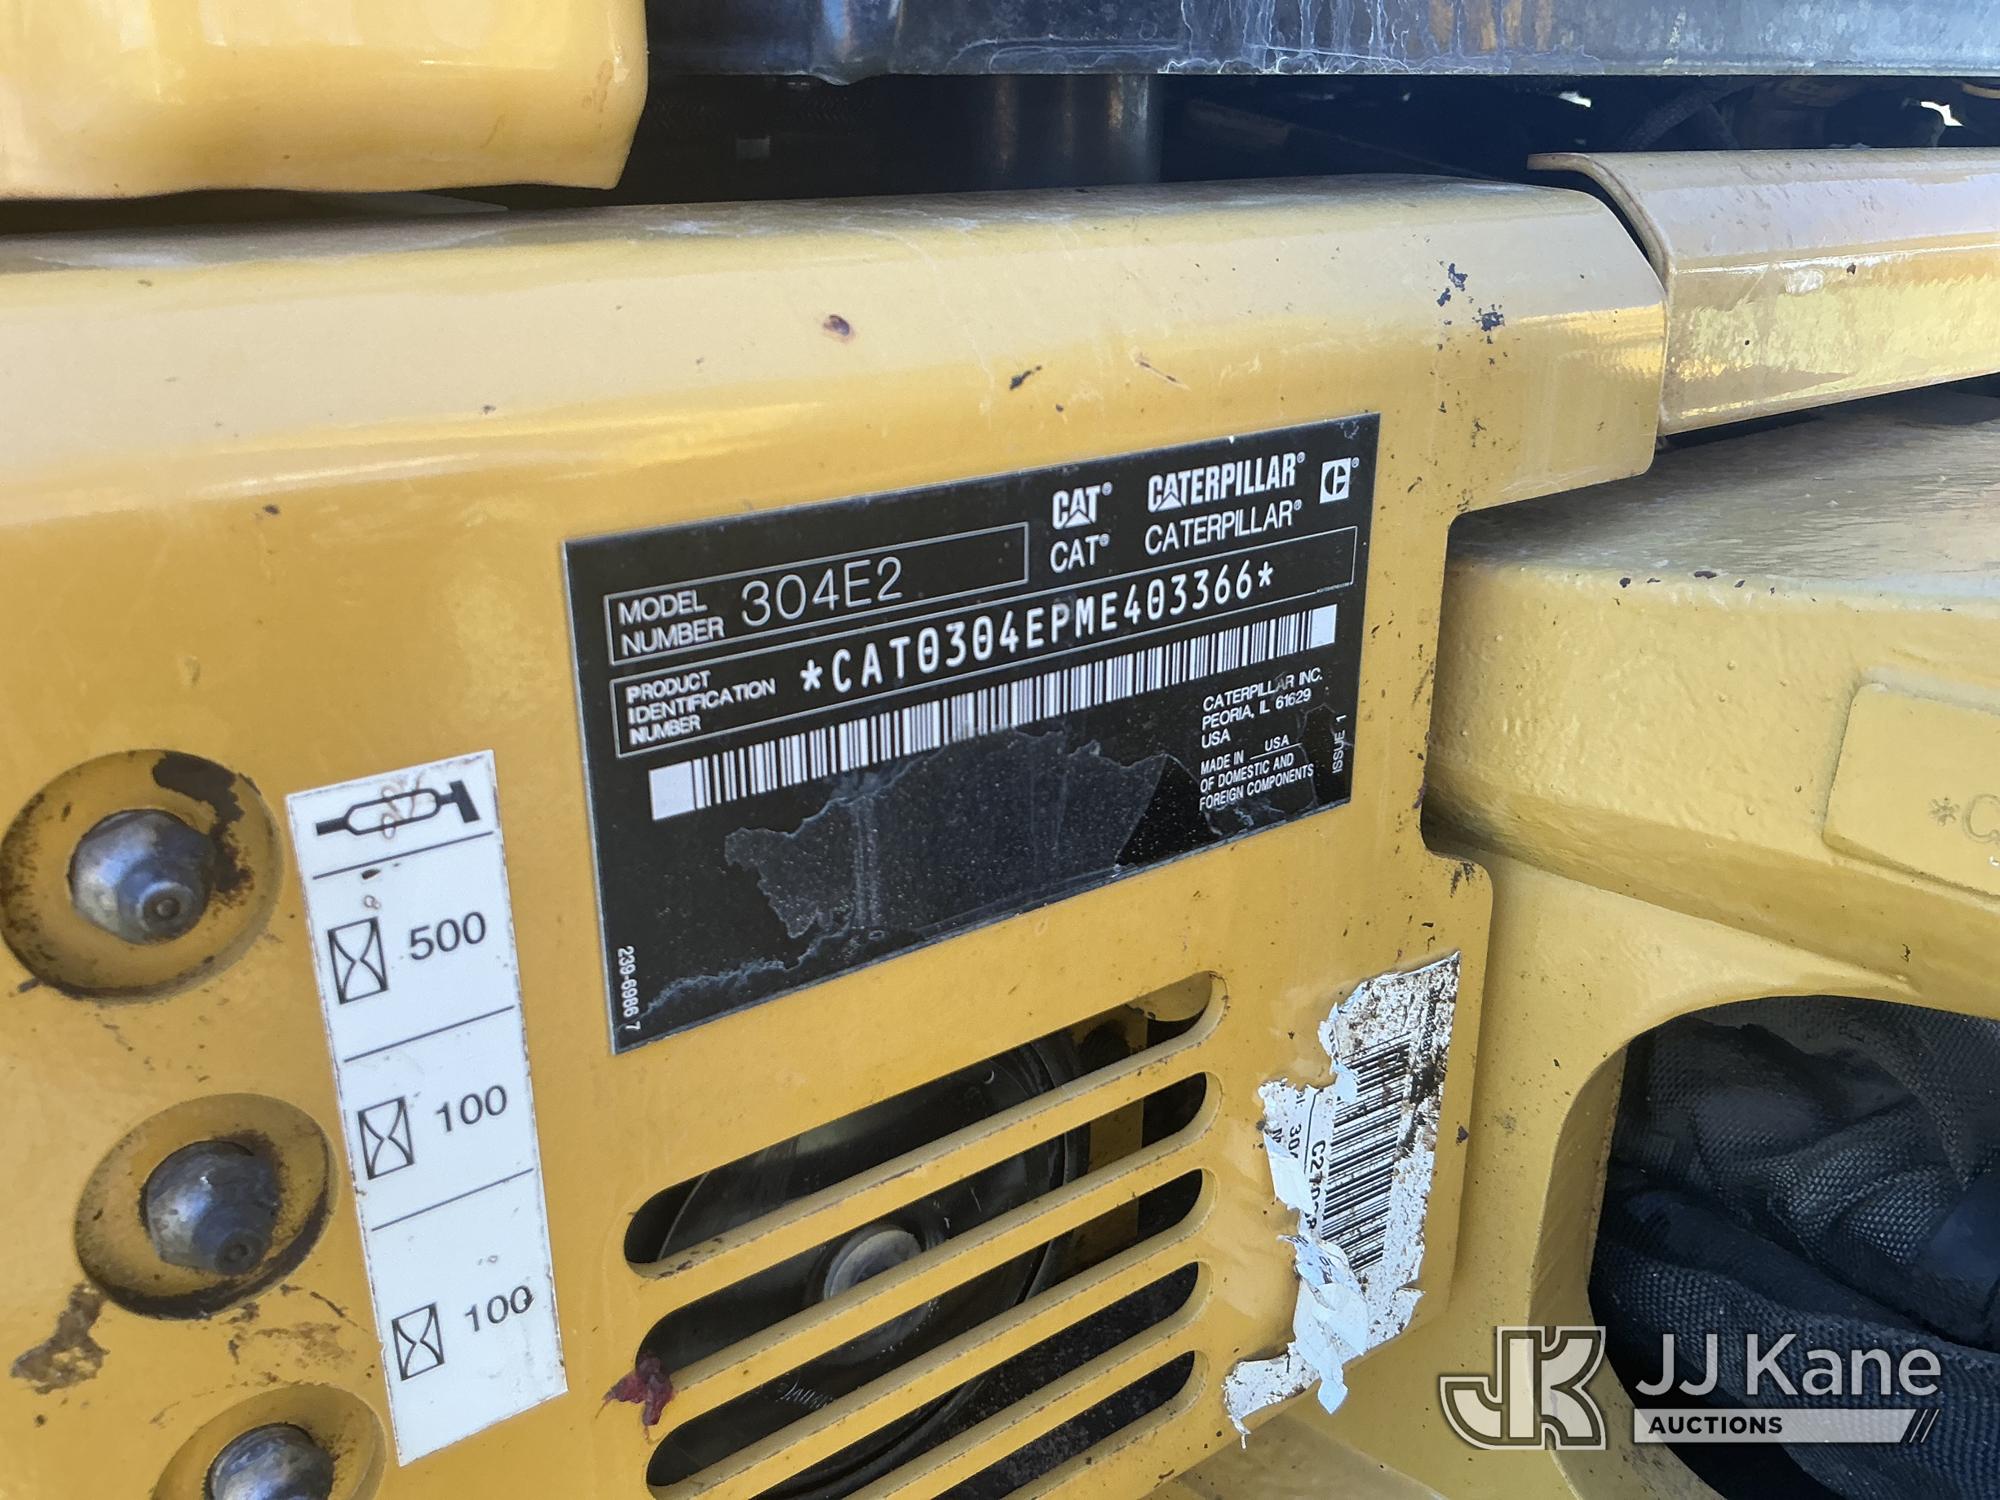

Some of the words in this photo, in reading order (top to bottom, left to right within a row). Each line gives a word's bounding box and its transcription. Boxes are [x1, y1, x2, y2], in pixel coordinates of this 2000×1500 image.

[618, 589, 708, 627] MODEL
[741, 556, 903, 628] 304E2
[621, 616, 725, 658] NUMBER
[626, 670, 711, 705] PRODUCT
[627, 678, 777, 724] IDENTIFICATION
[1202, 705, 1255, 731] PEORIA,
[1259, 702, 1271, 716] IL
[1275, 687, 1312, 710] 61629
[1203, 673, 1294, 712] CATERPILLAR
[1298, 667, 1323, 686] INC.
[629, 715, 702, 746] NUMBER
[1201, 729, 1231, 749] USA
[1335, 714, 1347, 724] 1
[1200, 753, 1230, 775] MADE
[1233, 750, 1244, 765] IN
[1264, 735, 1290, 752] USA
[1200, 777, 1216, 793] OF
[1217, 758, 1269, 788] DOMESTIC
[1272, 752, 1294, 770] AND
[1332, 729, 1346, 774] ISSUE
[1199, 786, 1244, 811] FOREIGN
[1246, 763, 1315, 796] COMPONENTS
[409, 911, 486, 961] 500
[625, 1020, 641, 1032] 7
[435, 1085, 508, 1133] 100
[464, 1285, 534, 1333] 100
